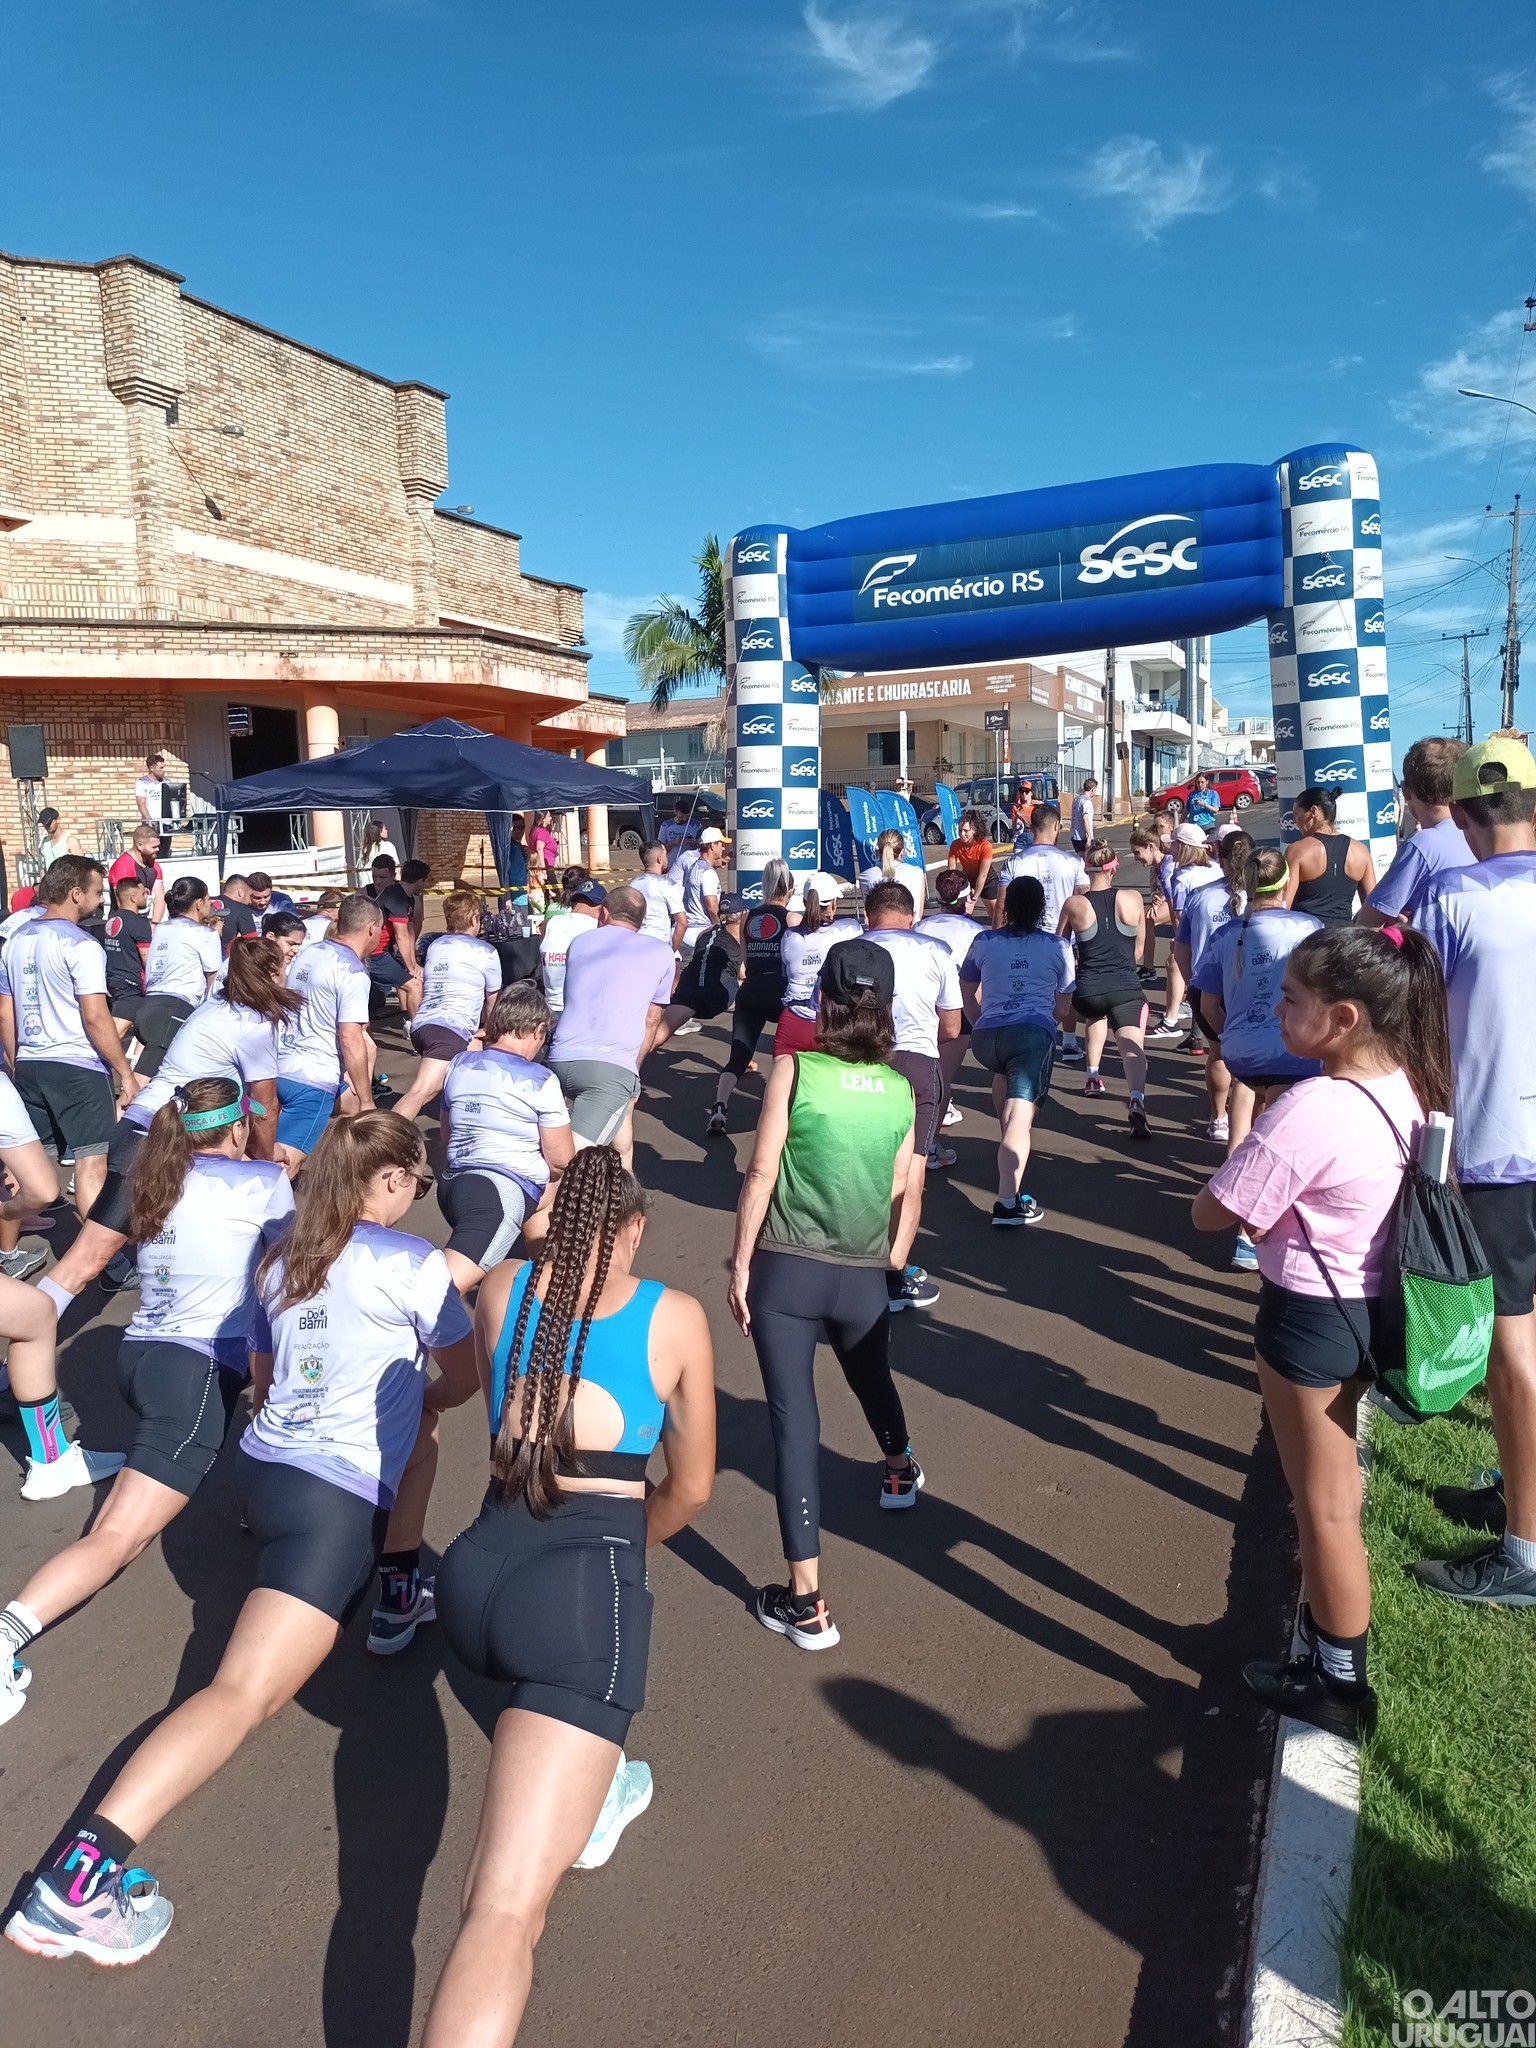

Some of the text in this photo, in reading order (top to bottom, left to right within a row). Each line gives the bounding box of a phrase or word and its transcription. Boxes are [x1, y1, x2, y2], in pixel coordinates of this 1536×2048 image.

[1298, 472, 1343, 491] Sesc
[737, 550, 771, 564] Sesc
[1076, 537, 1198, 585] Sesc
[873, 570, 1045, 609] Fecomércio RS
[1301, 573, 1345, 591] Sesc
[1302, 626, 1342, 637] Fecomércio
[740, 637, 775, 650] Sesc
[1307, 671, 1351, 688] Sesc
[867, 686, 875, 702] E
[877, 678, 972, 701] CHURRASCARIA
[742, 722, 776, 735] Sesc
[1308, 723, 1349, 733] Fecomércio
[1313, 767, 1358, 783] Sesc
[741, 806, 775, 819] Sesc
[832, 833, 844, 867] Sesc
[841, 1071, 887, 1095] LENA
[184, 1118, 208, 1128] ORÇA
[218, 1110, 229, 1121] FÉ
[151, 1234, 176, 1245] Barril
[901, 1286, 920, 1295] FILA
[299, 1316, 328, 1331] Barril
